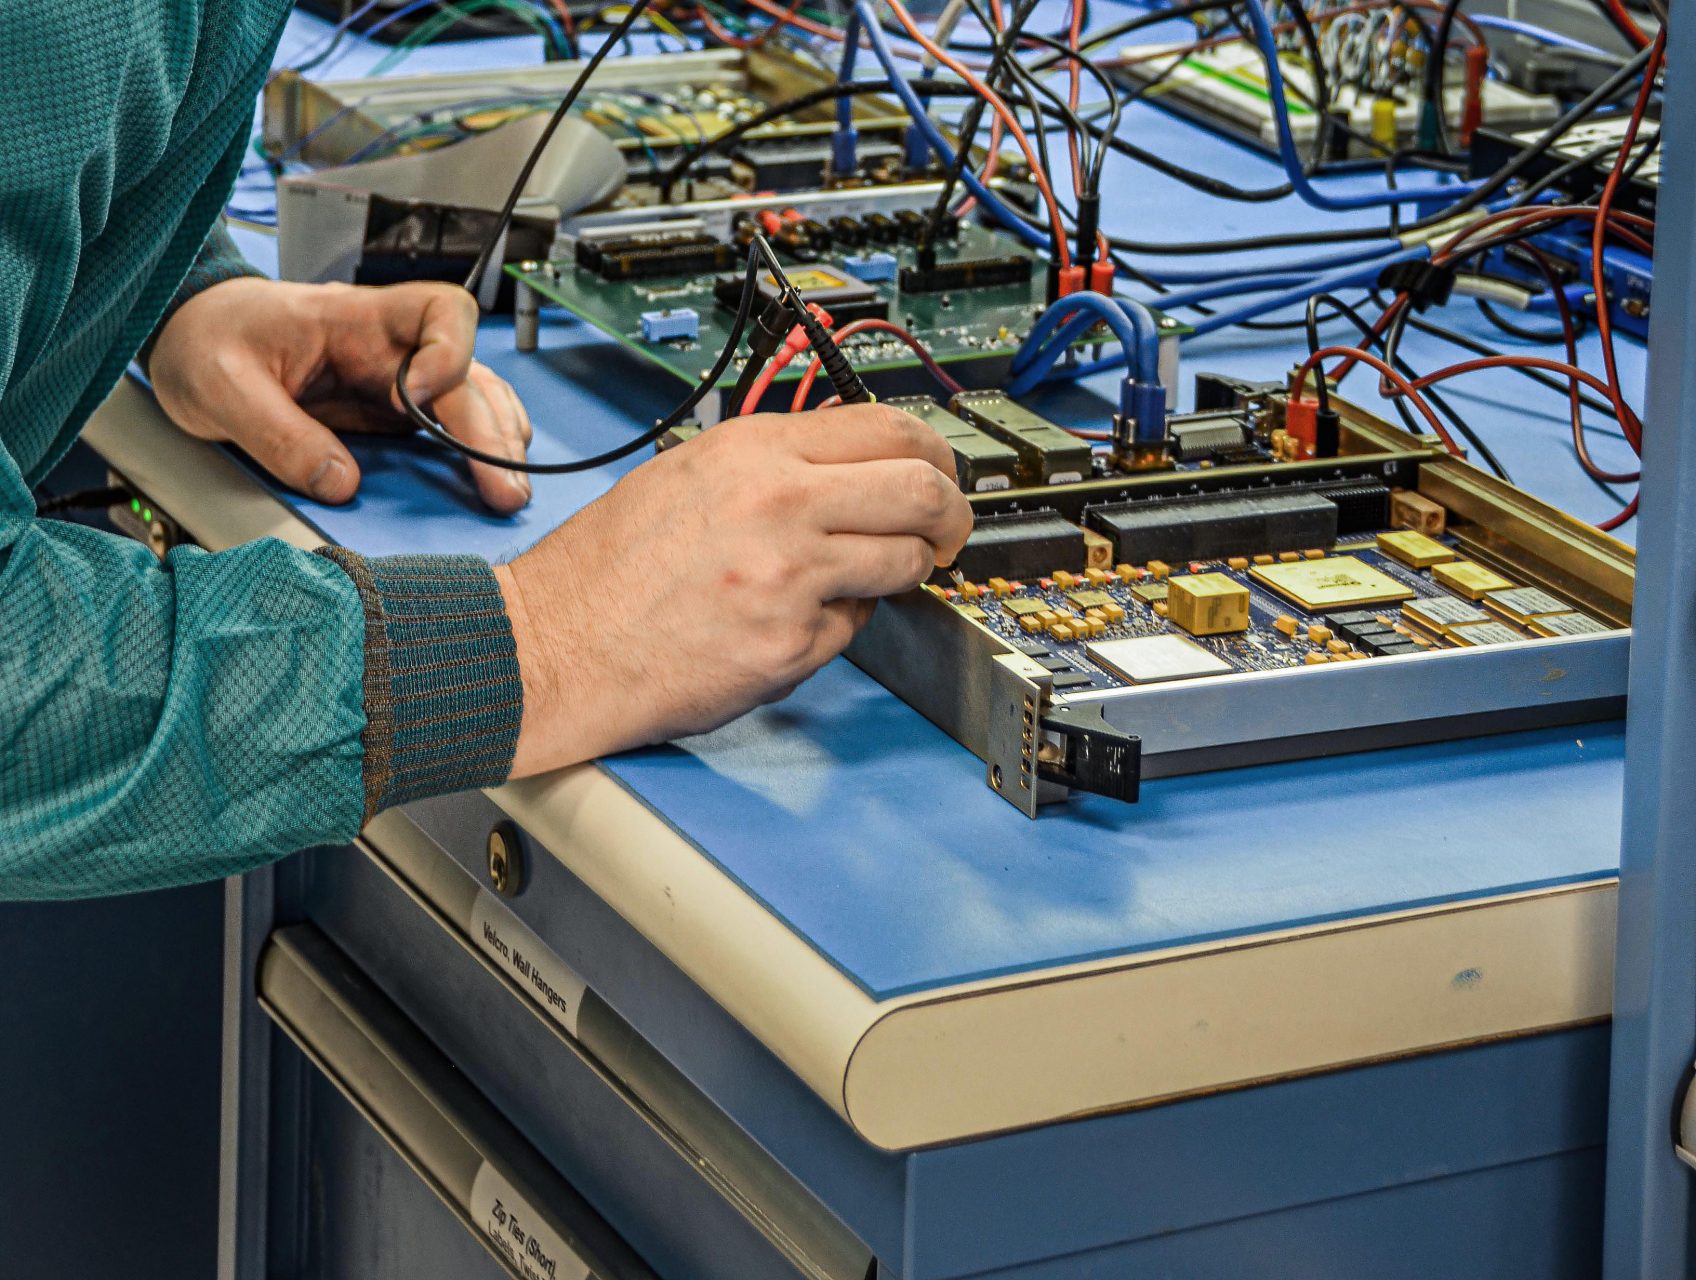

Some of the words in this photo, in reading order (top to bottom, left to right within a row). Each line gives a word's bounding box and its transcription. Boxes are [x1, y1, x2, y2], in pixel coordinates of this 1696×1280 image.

[483, 921, 510, 963] Velcro,
[512, 948, 531, 979] Wall
[531, 967, 567, 1013] Hangers
[491, 1198, 506, 1226] Zip
[508, 1213, 526, 1246] Ties
